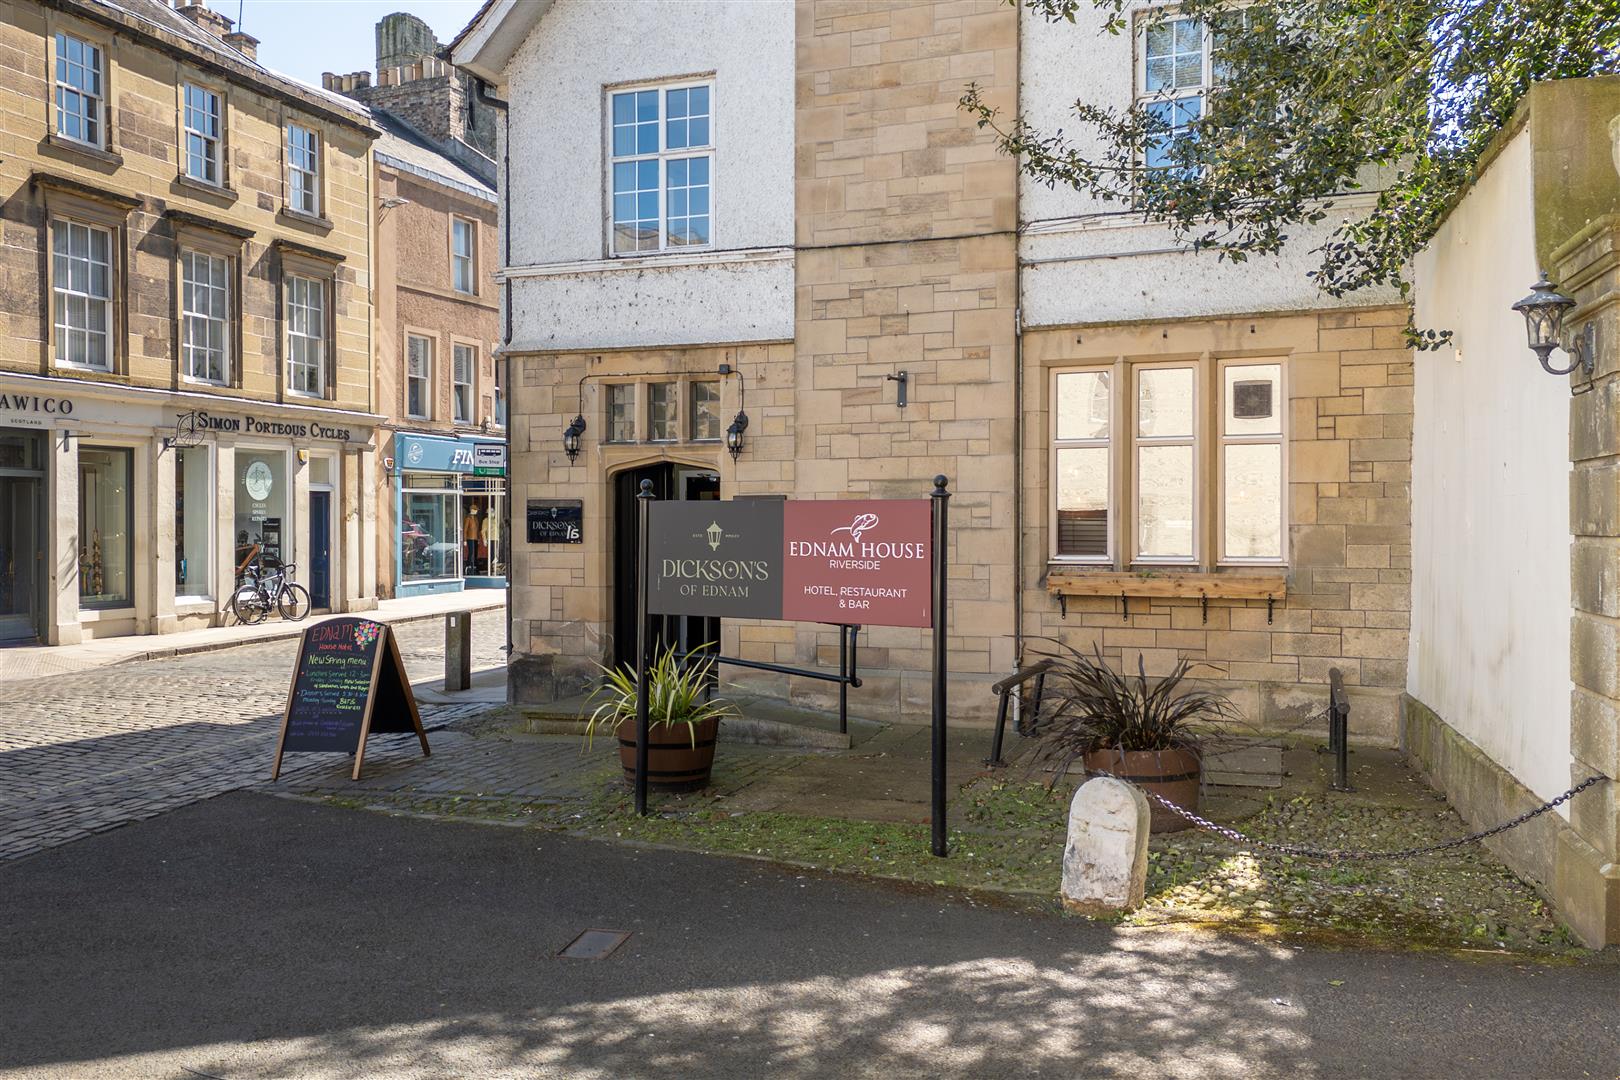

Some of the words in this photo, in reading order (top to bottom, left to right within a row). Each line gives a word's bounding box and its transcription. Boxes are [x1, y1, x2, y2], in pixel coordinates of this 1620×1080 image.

[198, 411, 240, 431] SIMON
[245, 416, 306, 436] PORTEOUS
[310, 423, 350, 440] CYCLES
[790, 542, 854, 557] EDNAM
[861, 542, 925, 559] HOUSE
[663, 559, 769, 581] DICKSON'S
[829, 560, 880, 570] RIVERSIDE
[680, 584, 698, 596] OF
[702, 585, 749, 598] EDNAM
[804, 585, 838, 597] HOTEL,
[840, 587, 907, 598] RESTAURANT
[839, 599, 846, 608] &
[849, 600, 870, 609] BAR
[308, 655, 325, 666] New
